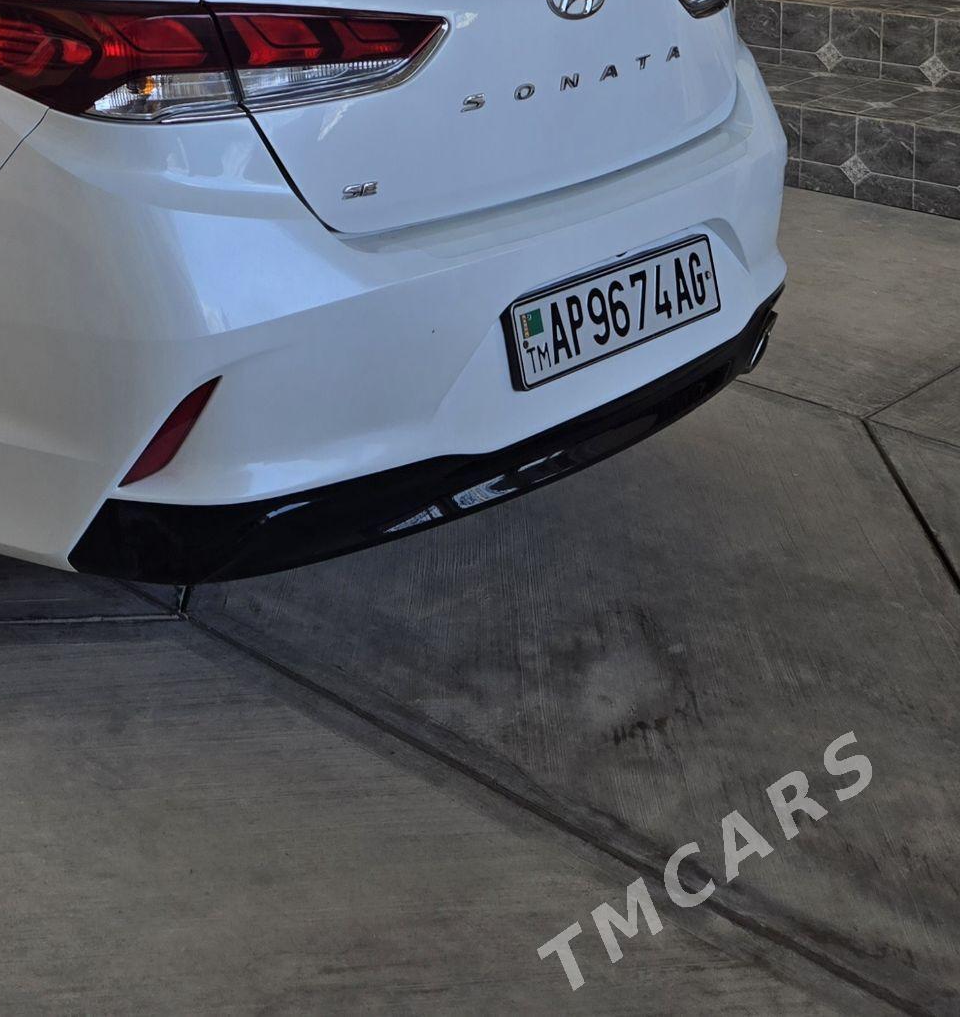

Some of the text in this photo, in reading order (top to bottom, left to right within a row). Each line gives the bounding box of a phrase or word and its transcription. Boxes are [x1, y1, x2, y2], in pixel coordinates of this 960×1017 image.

[460, 45, 681, 113] SONATA
[342, 181, 379, 200] SE
[526, 252, 706, 374] TM AP9674AG
